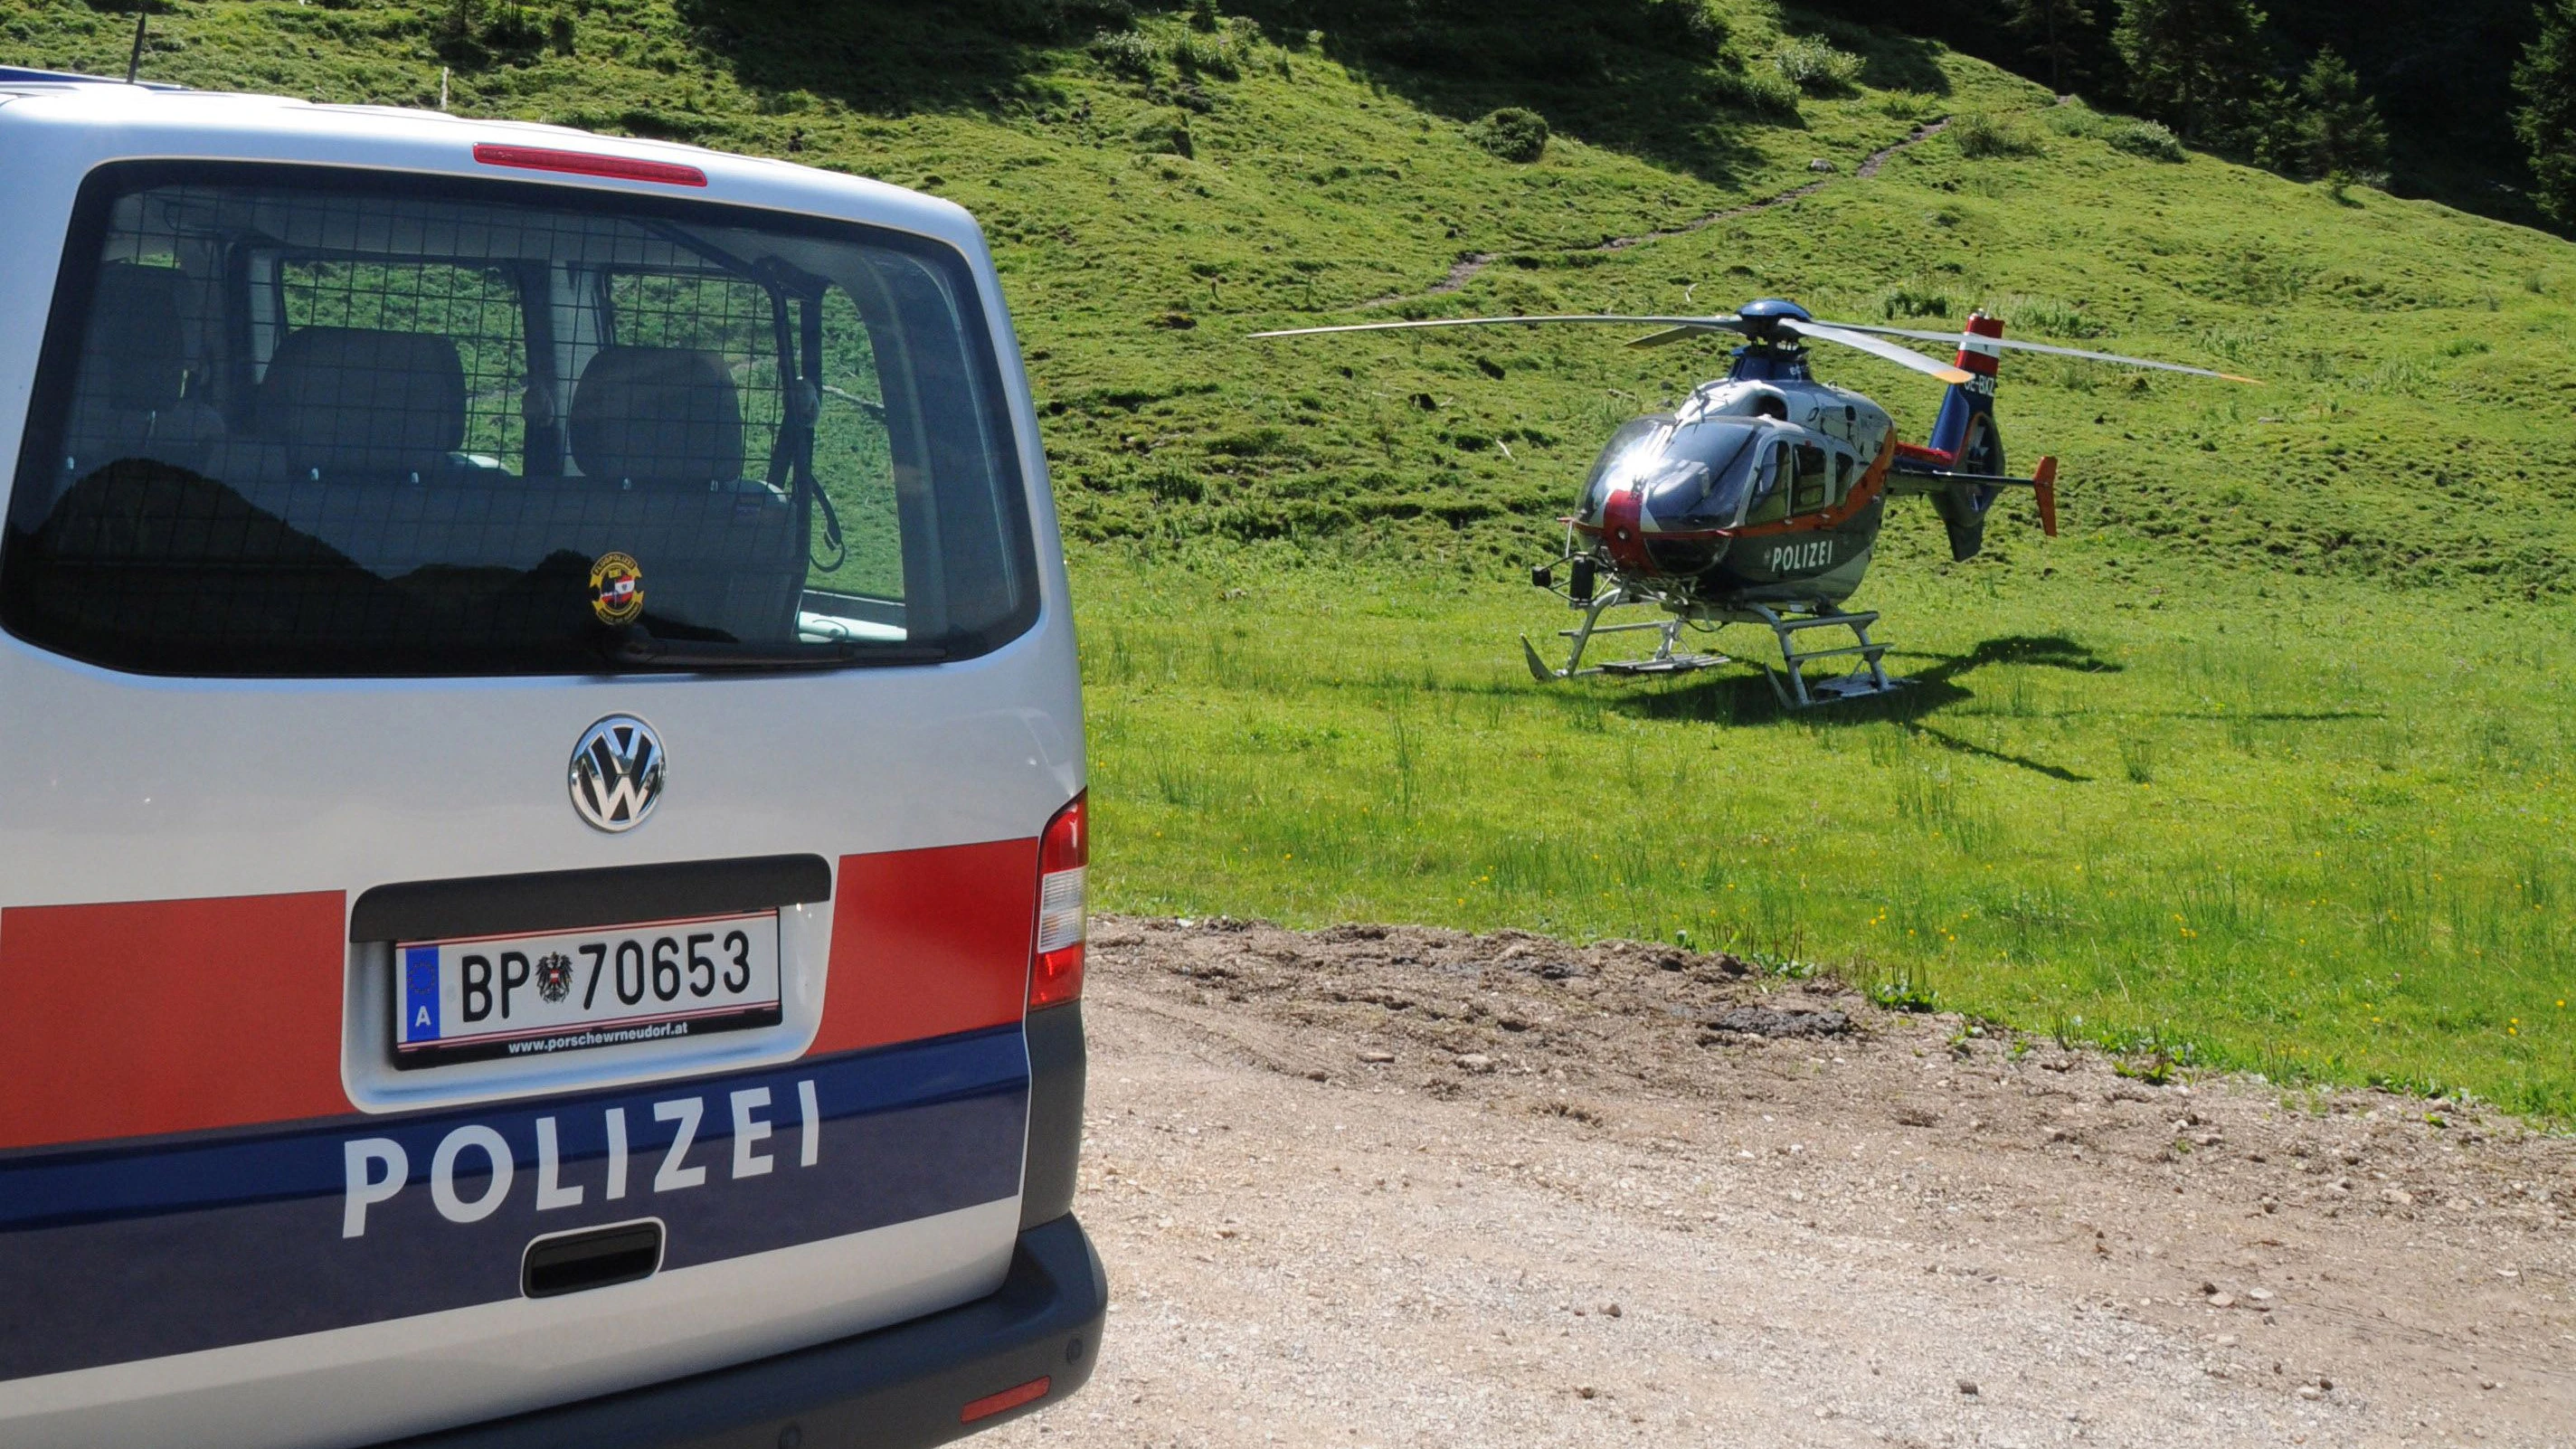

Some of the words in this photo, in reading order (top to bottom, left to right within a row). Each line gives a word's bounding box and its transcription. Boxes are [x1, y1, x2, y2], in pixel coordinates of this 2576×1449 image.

[1772, 539, 1833, 572] POLIZEI
[573, 718, 664, 825] VW
[461, 952, 530, 1023] BP
[578, 930, 750, 1010] 70653
[415, 1005, 431, 1028] A
[508, 1021, 687, 1054] www.porschewrneudorf.at
[342, 1079, 819, 1239] POLIZEI
